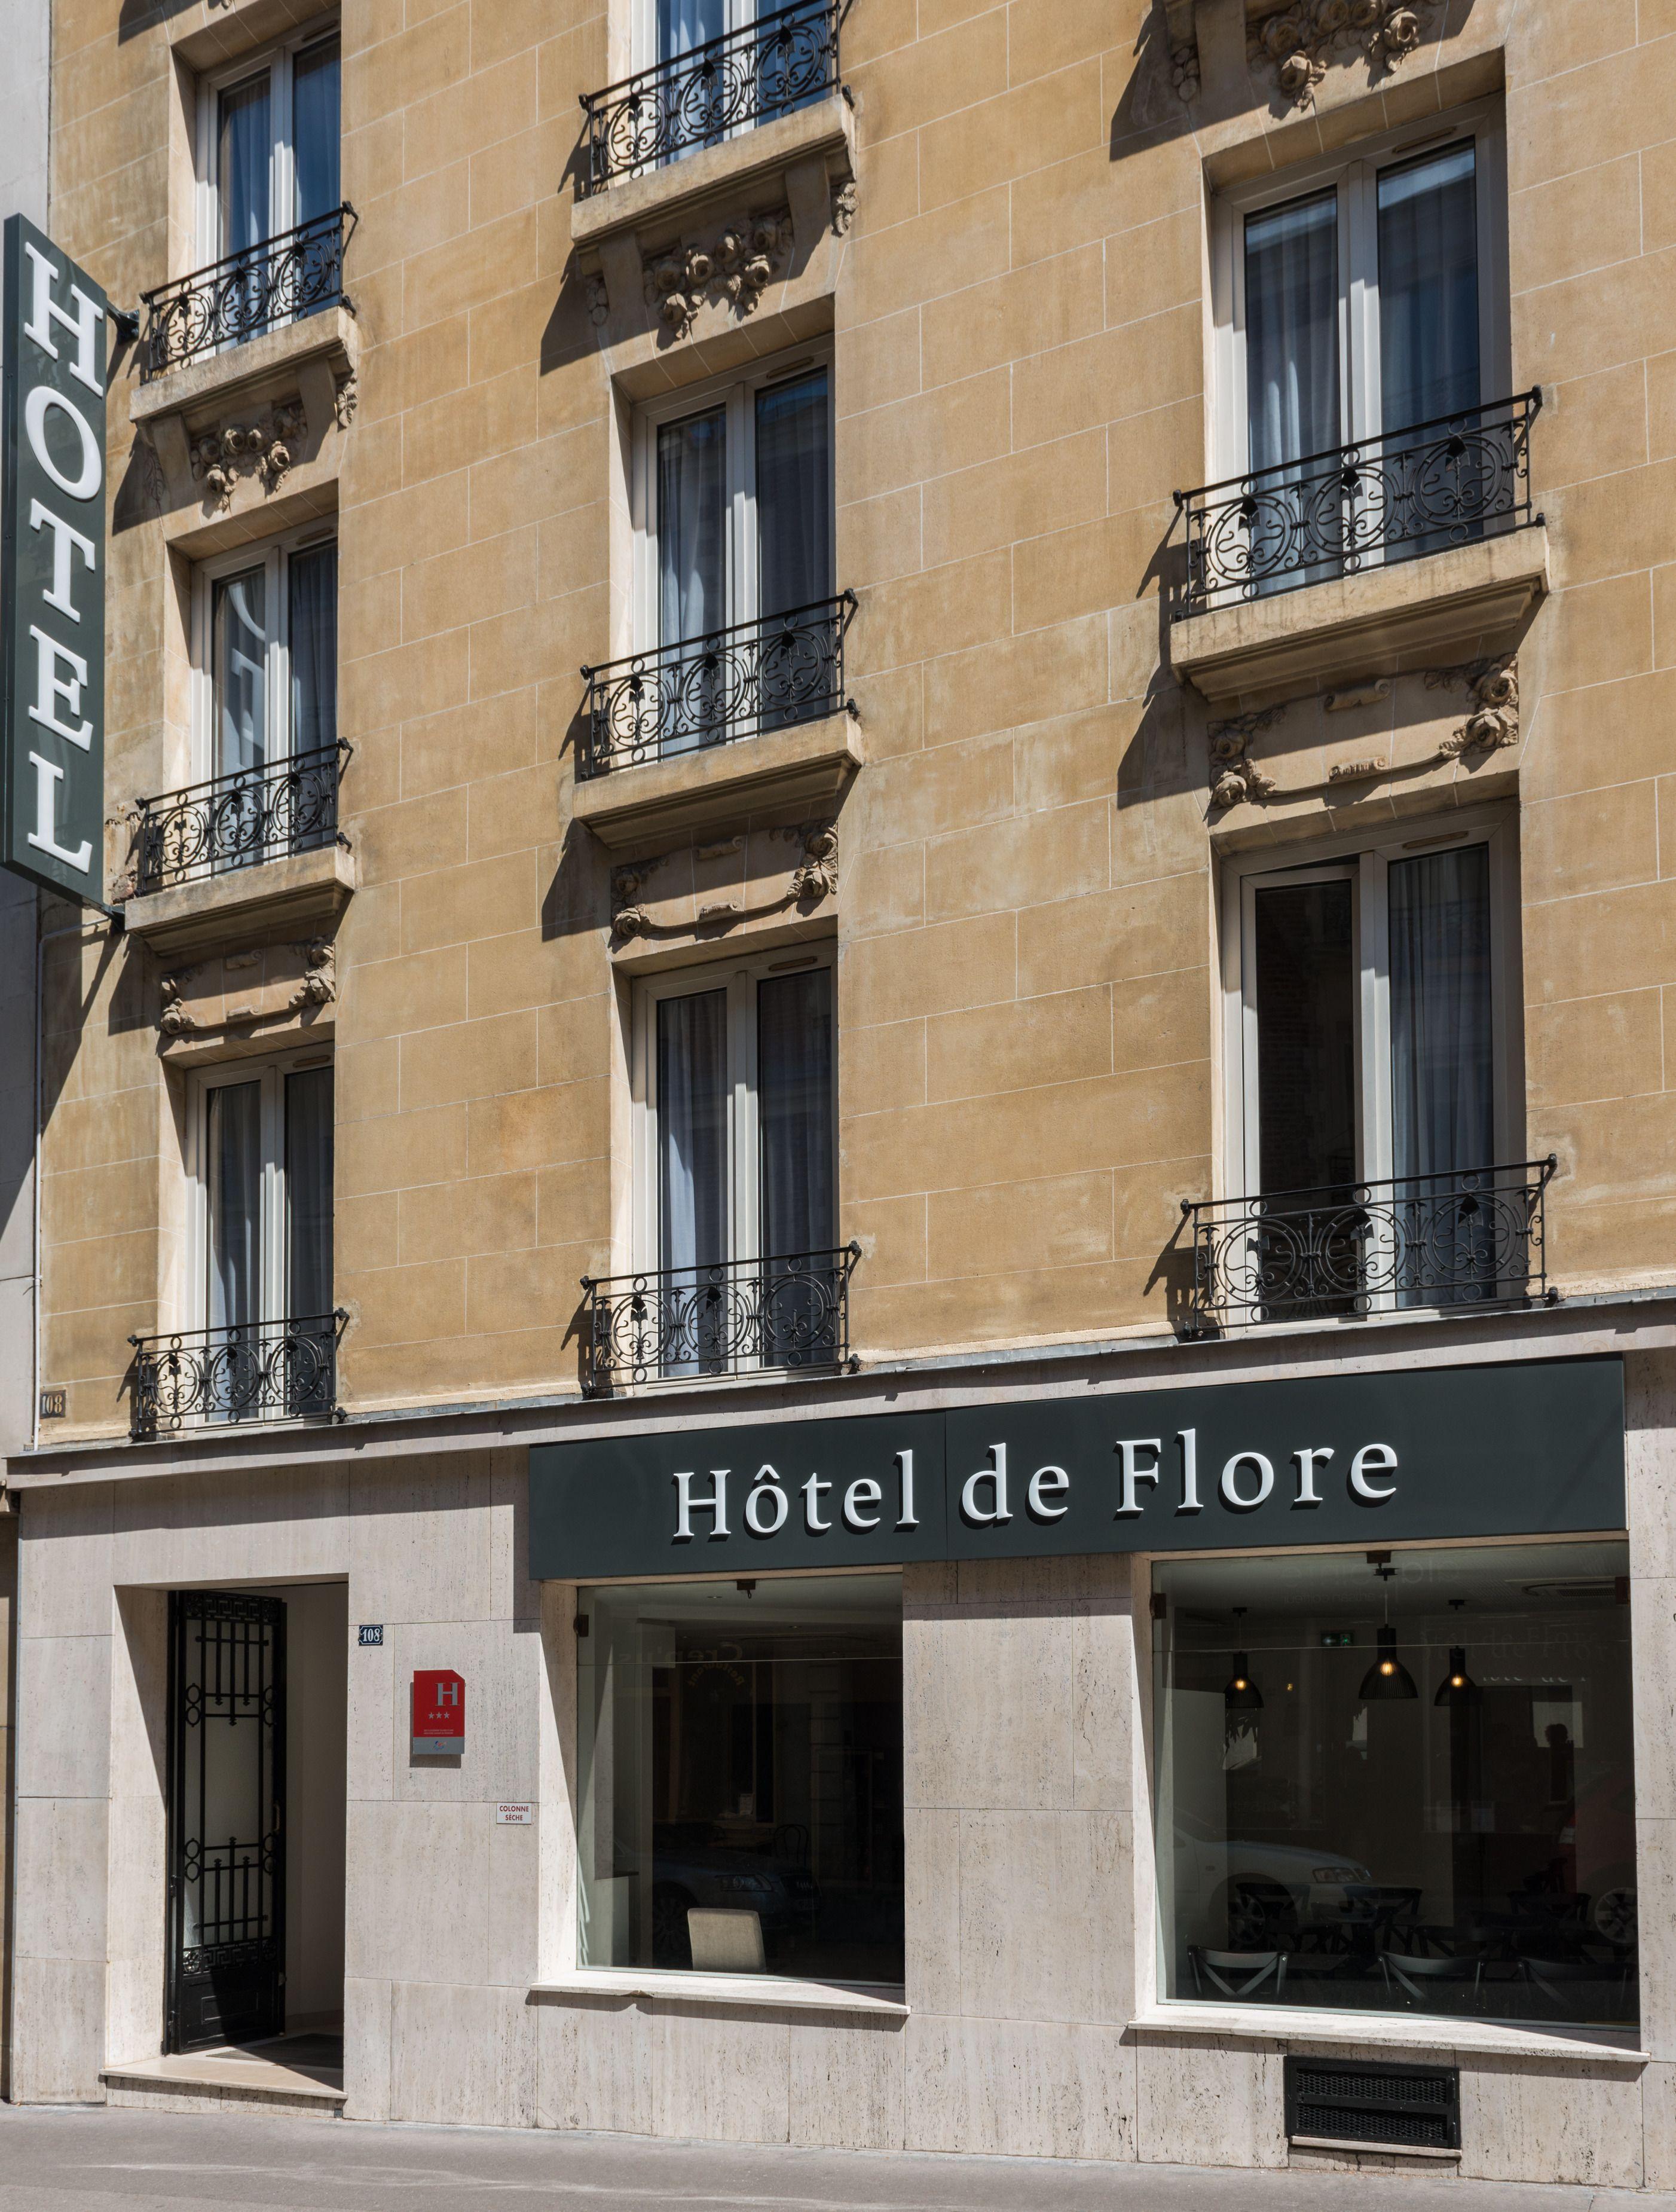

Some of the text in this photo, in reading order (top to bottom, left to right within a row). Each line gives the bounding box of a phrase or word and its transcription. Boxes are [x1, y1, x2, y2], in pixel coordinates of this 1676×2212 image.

[24, 242, 104, 874] HOTEL
[42, 1395, 63, 1414] 108
[672, 1428, 1399, 1538] Hôtel de Flore
[362, 1629, 380, 1642] 108
[435, 1682, 460, 1706] H
